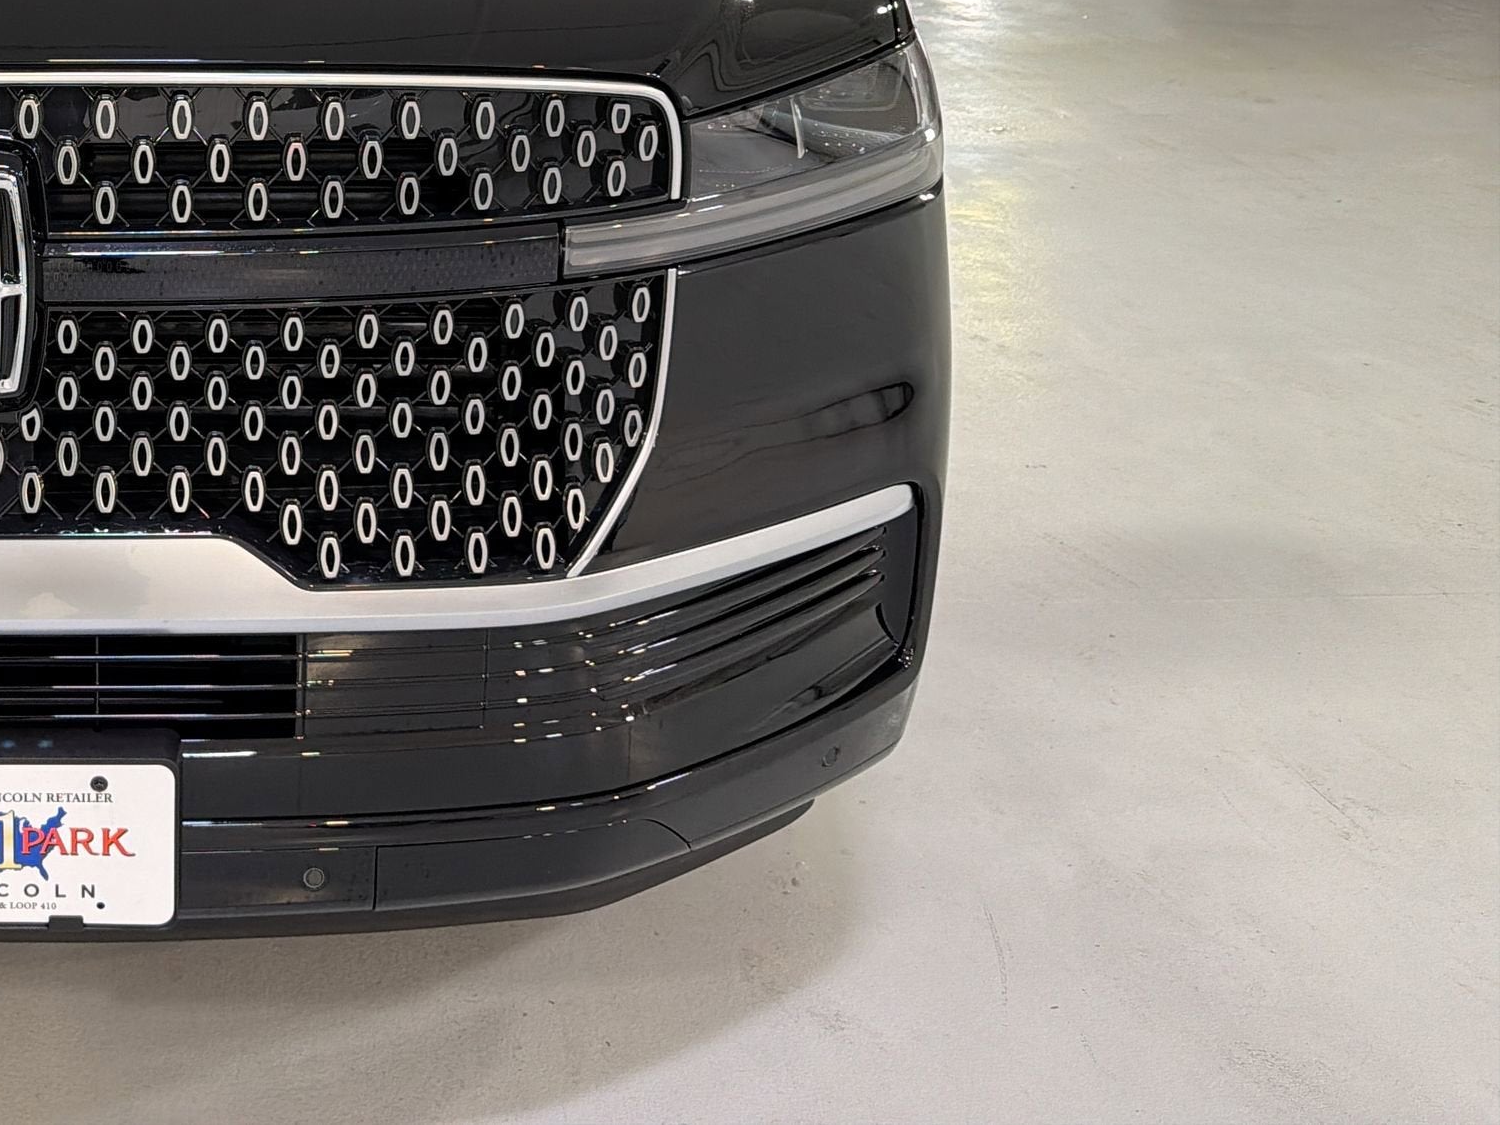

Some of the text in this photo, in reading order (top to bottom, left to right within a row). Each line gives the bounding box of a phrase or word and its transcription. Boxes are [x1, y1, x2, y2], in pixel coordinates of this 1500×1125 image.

[46, 793, 113, 803] RETAILER
[21, 827, 135, 856] PARK
[40, 902, 57, 910] 410
